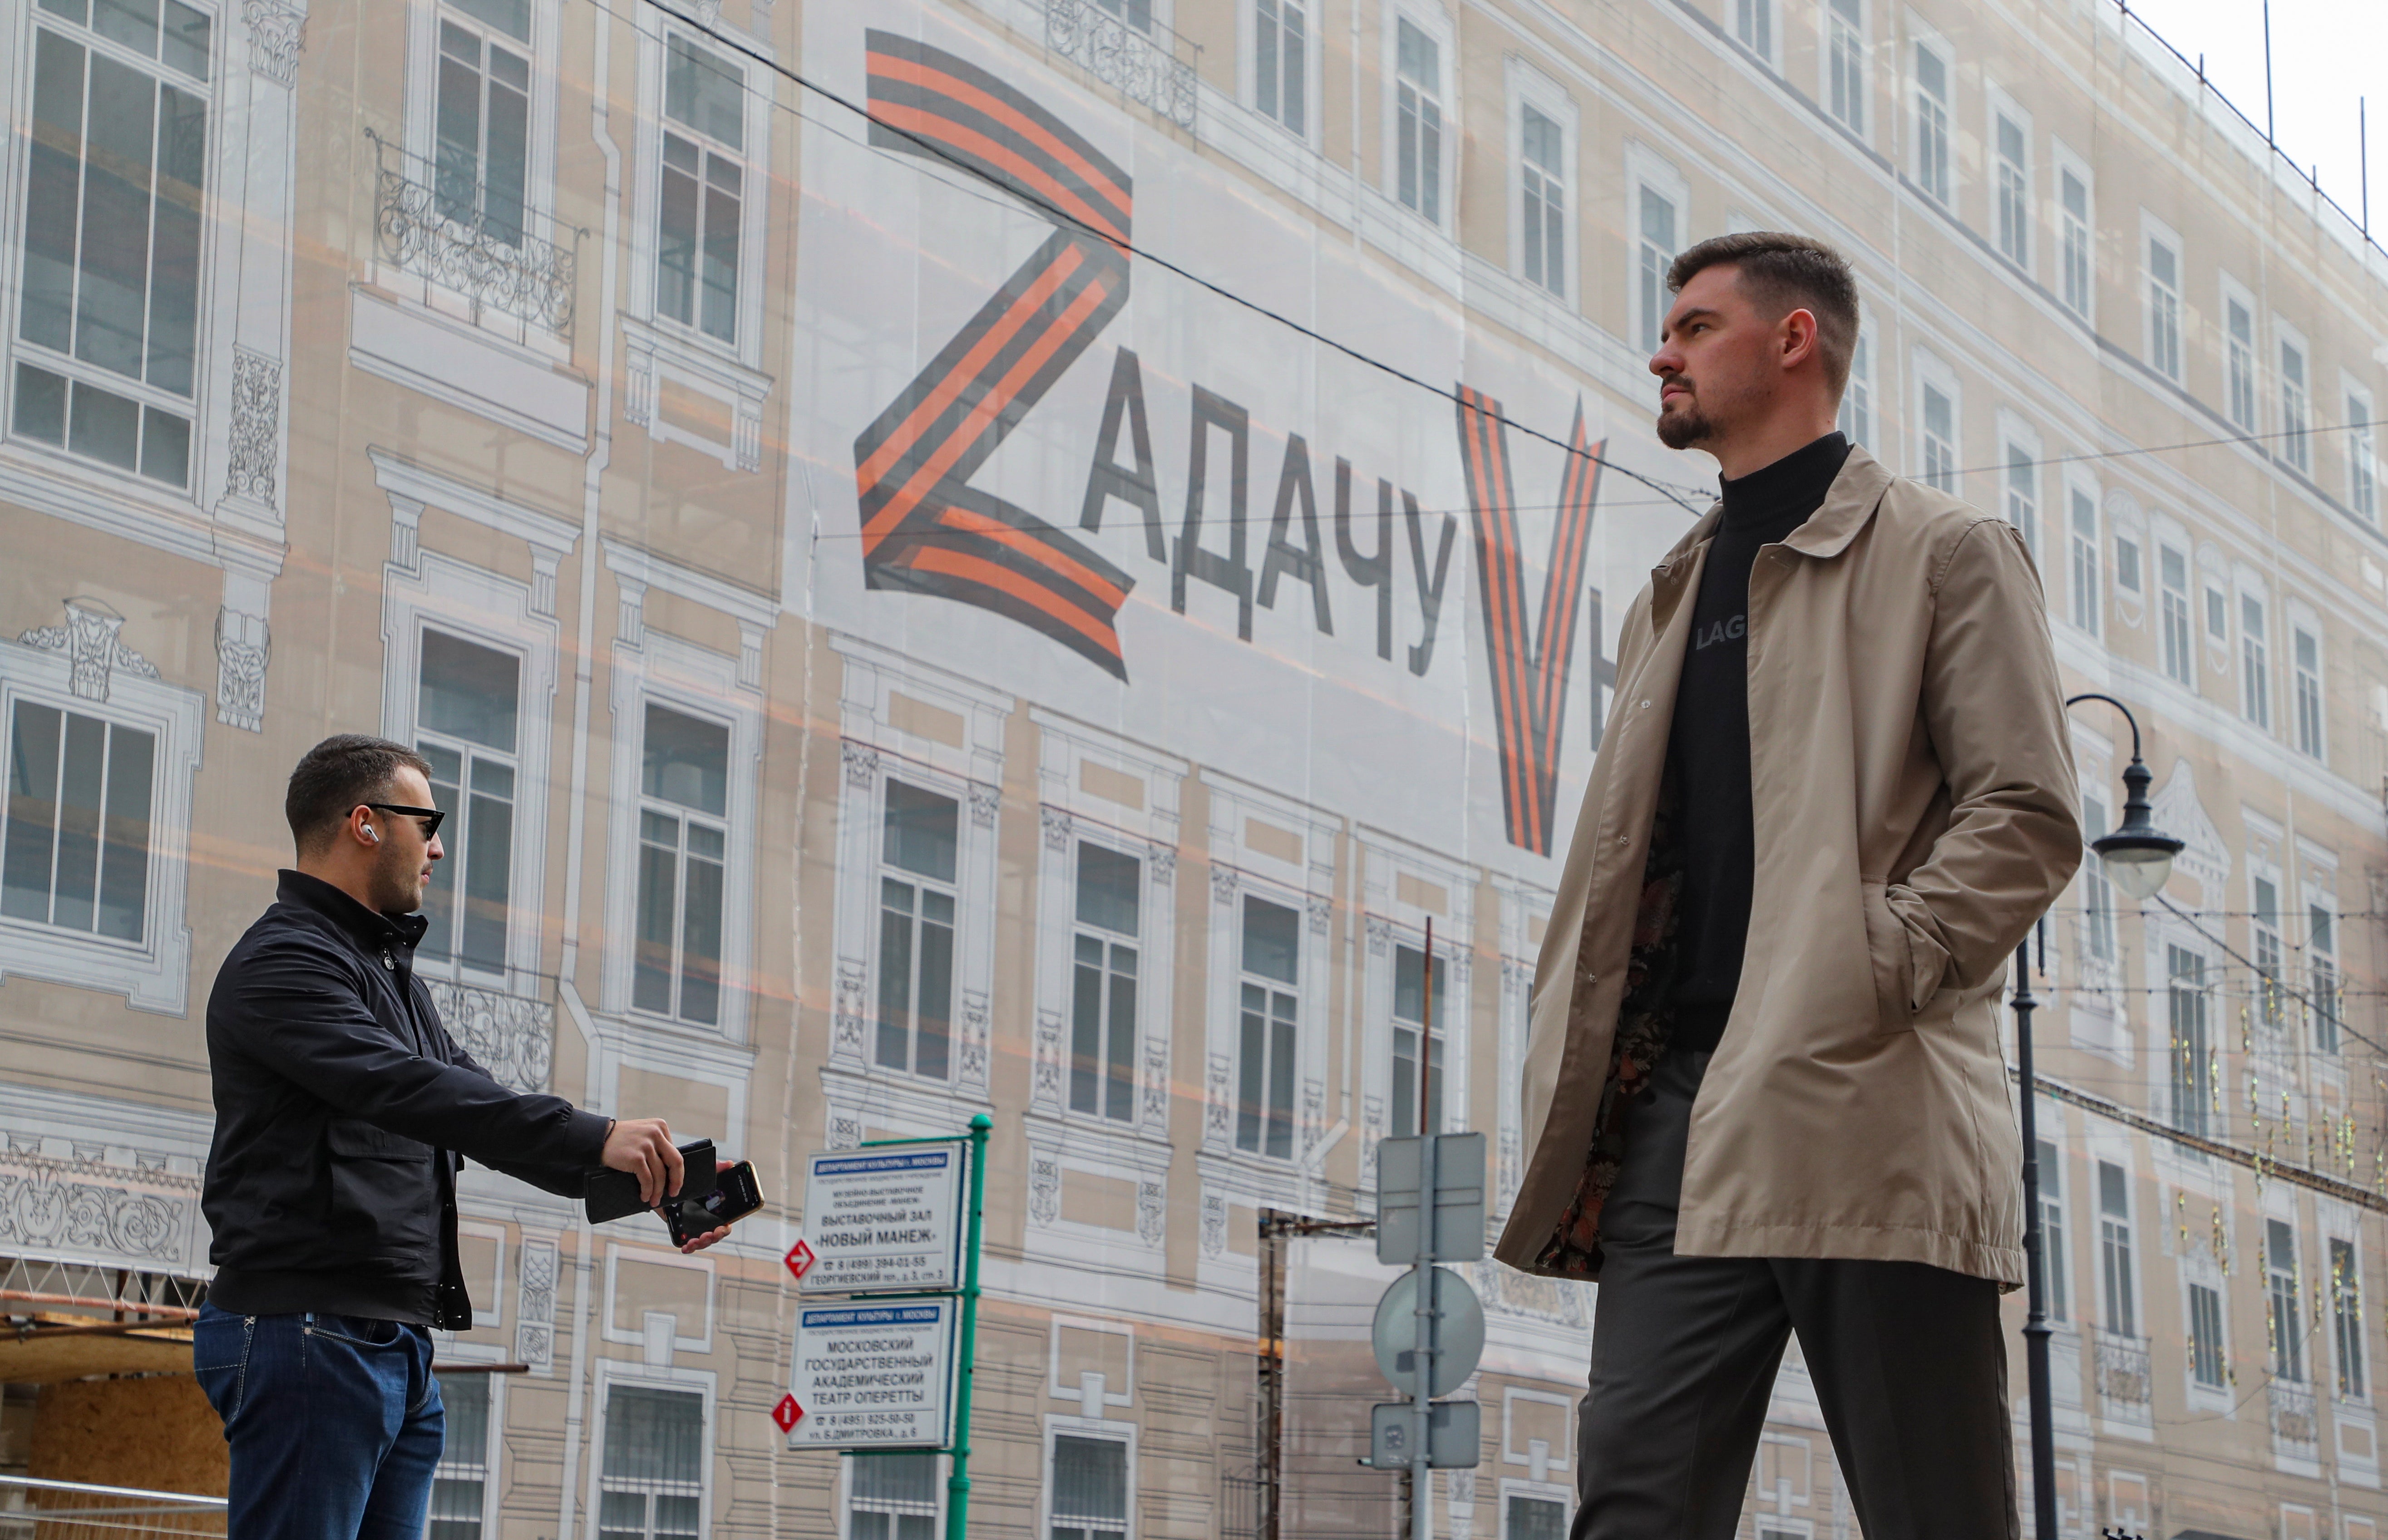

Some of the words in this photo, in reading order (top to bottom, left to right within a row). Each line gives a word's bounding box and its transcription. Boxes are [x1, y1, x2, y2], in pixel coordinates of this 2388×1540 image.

[821, 1208, 907, 1226] ВЫСТАВОЧНЫЙ
[909, 1210, 933, 1222] ЗАЛ
[810, 1270, 880, 1285] ГЕОРГИЕВСКИЙ
[827, 1335, 914, 1353] МОСКОВСКИЙ
[805, 1352, 933, 1372] ГОСУДАРСТВЕННЫЙ
[812, 1370, 924, 1388] АКАДЕМИЧЕСКИЙ
[812, 1392, 852, 1405] ТЕАТР
[854, 1389, 924, 1404] ОПЕРЕТТЫ
[829, 1415, 836, 1426] 8
[910, 1426, 918, 1437] 6
